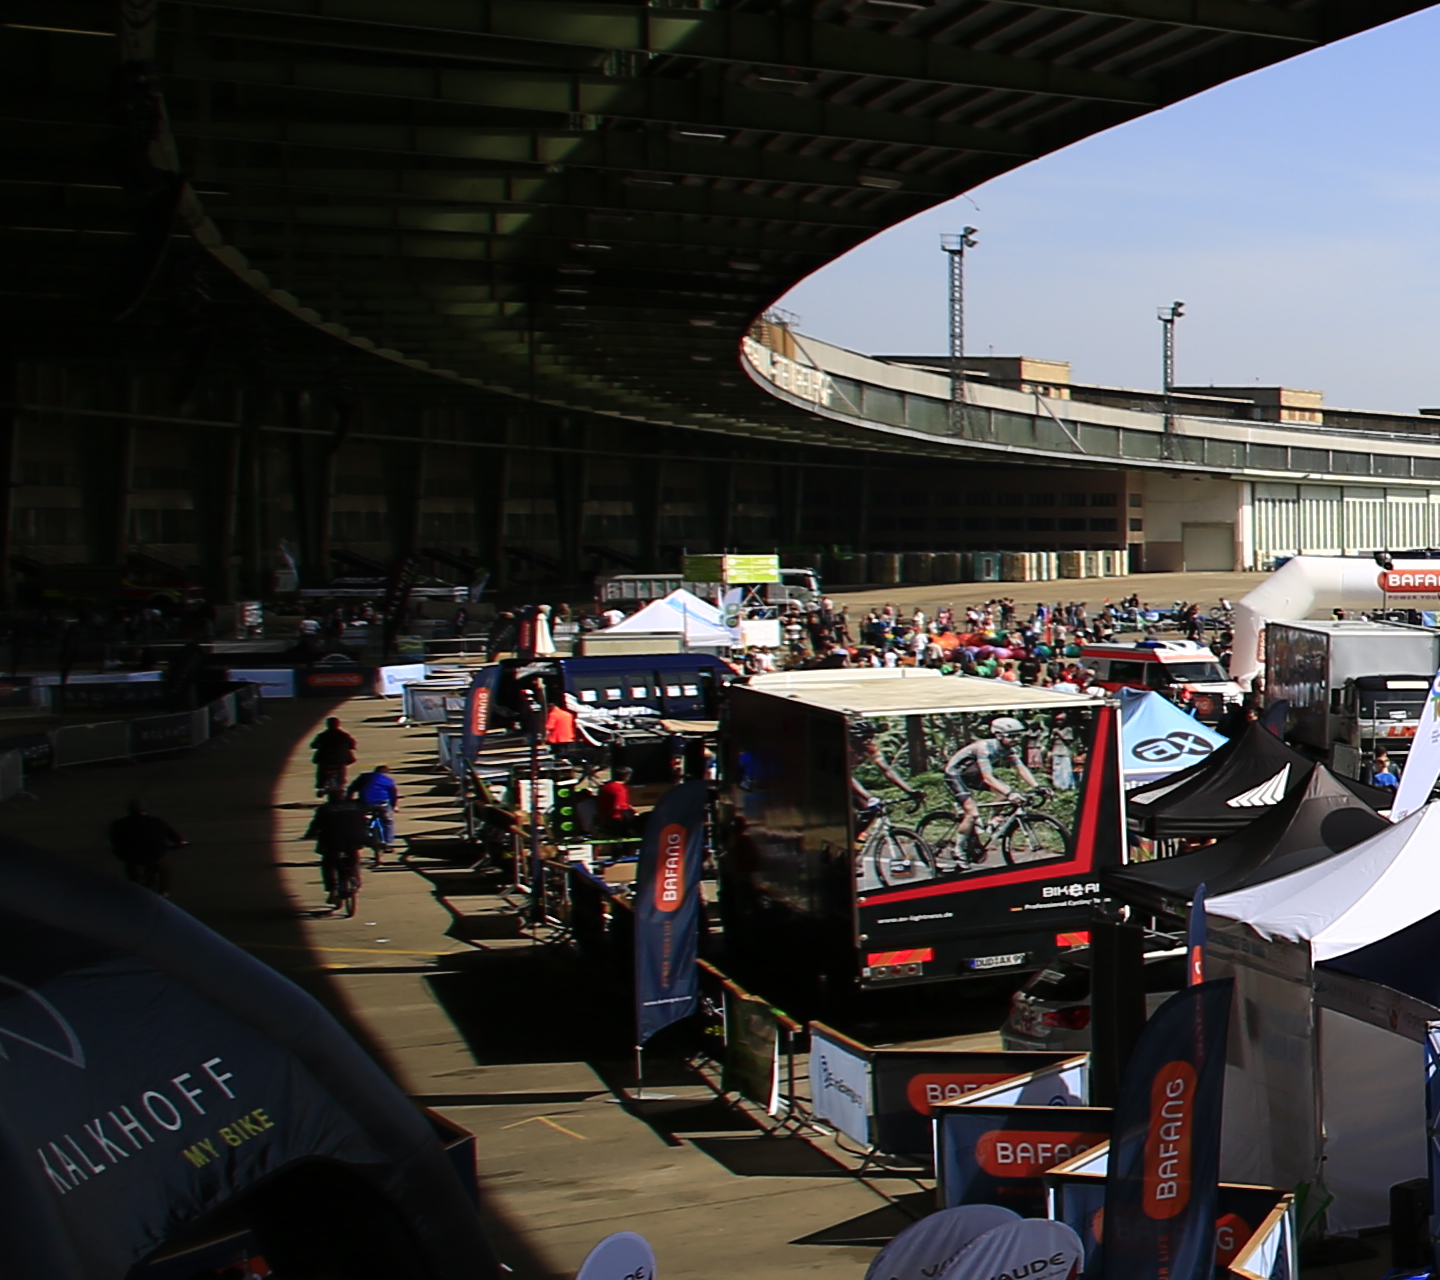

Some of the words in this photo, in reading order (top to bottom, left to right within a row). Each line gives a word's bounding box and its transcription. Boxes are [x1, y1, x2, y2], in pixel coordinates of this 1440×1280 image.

[662, 832, 682, 903] BAFANG
[182, 1137, 220, 1168] MY
[218, 1107, 275, 1147] BIKE
[1156, 1077, 1185, 1200] BAFANG
[1159, 1235, 1170, 1255] LIFE
